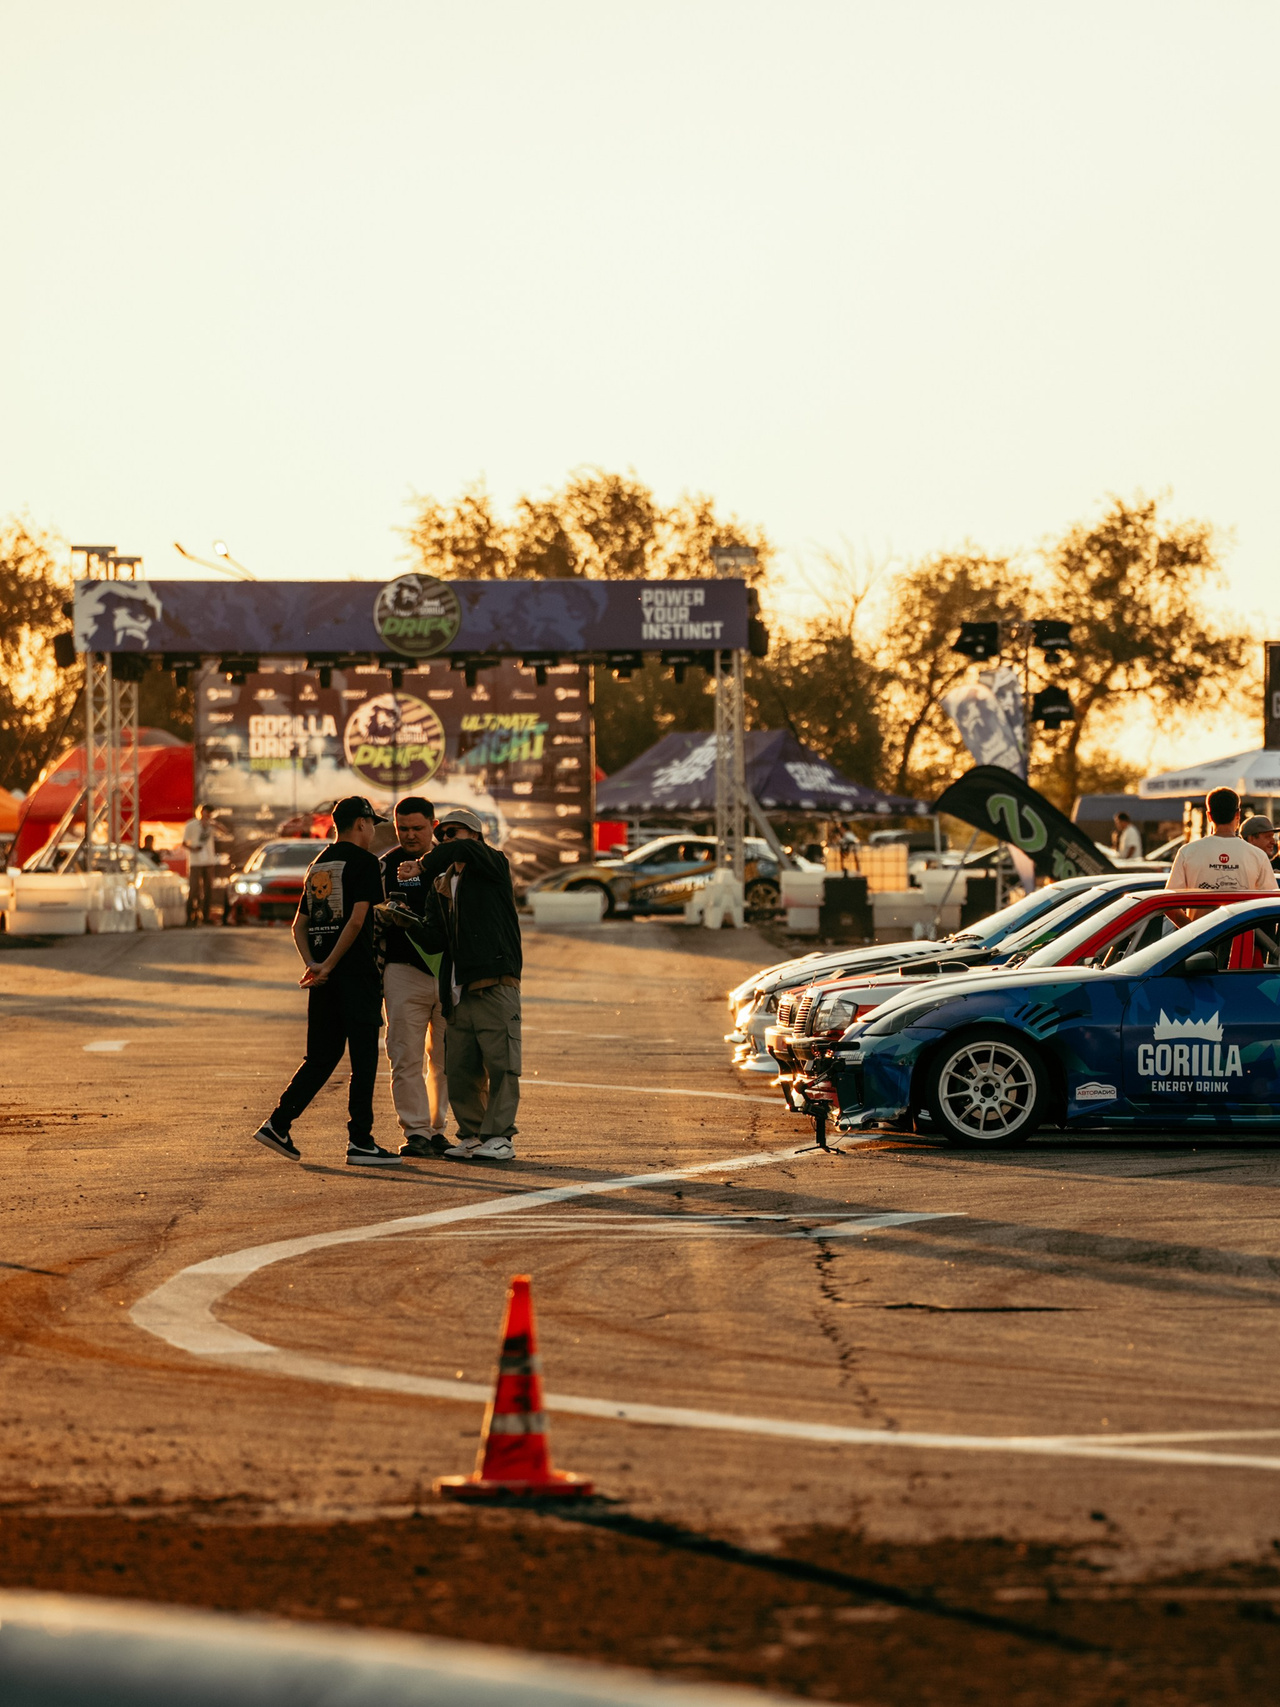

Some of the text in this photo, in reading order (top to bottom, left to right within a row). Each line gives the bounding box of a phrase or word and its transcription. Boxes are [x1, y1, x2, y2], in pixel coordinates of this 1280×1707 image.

[642, 588, 705, 606] POWER
[642, 606, 690, 622] YOUR
[642, 621, 724, 640] INSTINCT
[249, 715, 337, 737] GORILLA
[460, 713, 540, 731] ULTIMATE
[249, 736, 310, 758] DRIFT
[1137, 1043, 1243, 1077] GORILLA
[1152, 1081, 1229, 1092] ENERGY DRINK
